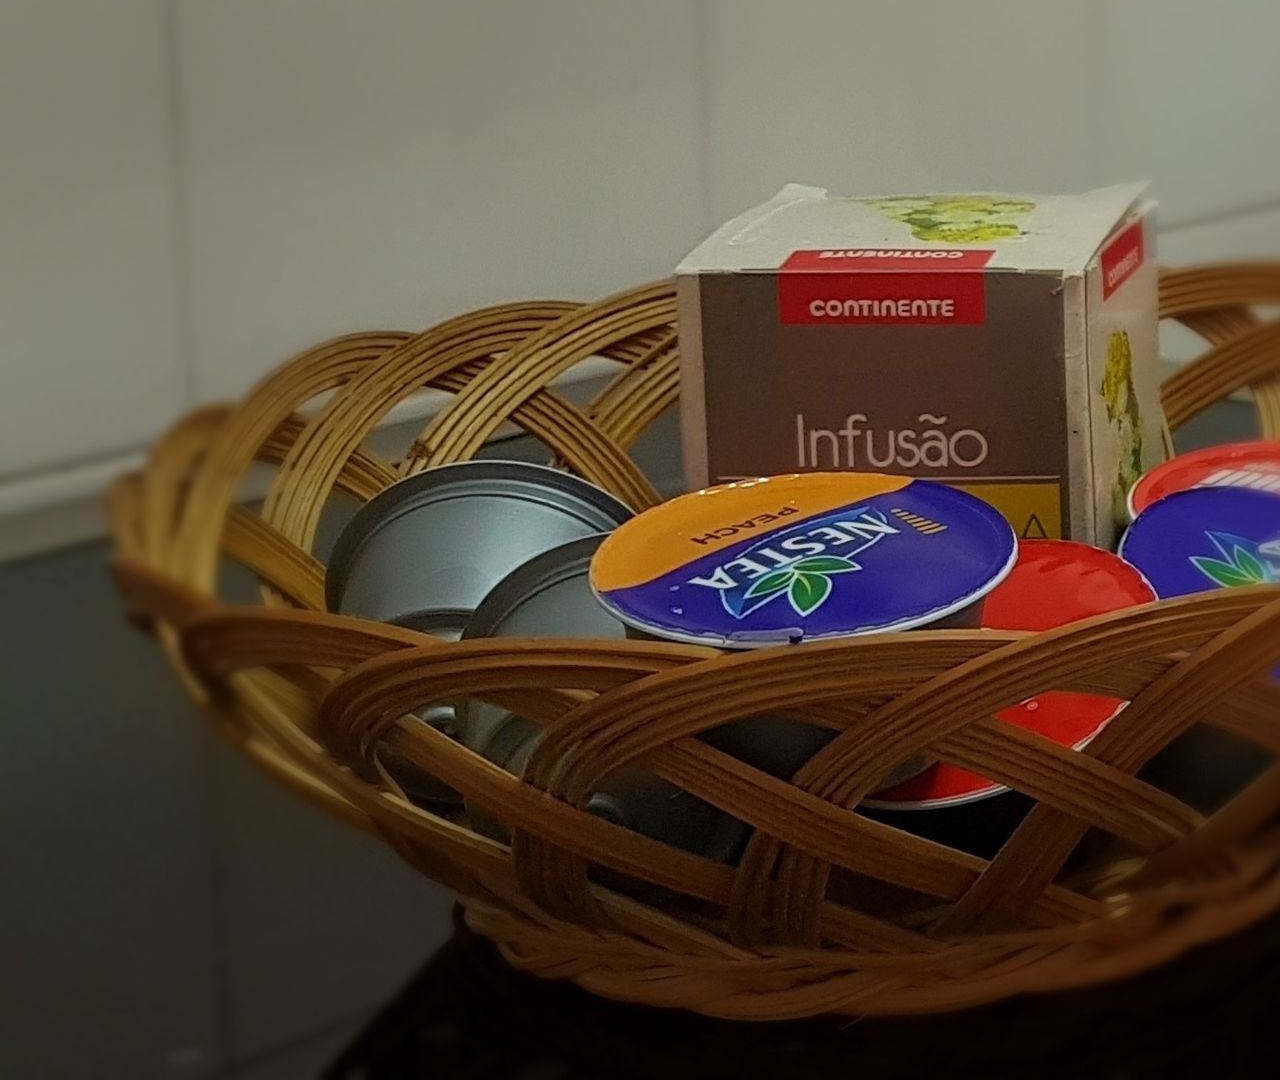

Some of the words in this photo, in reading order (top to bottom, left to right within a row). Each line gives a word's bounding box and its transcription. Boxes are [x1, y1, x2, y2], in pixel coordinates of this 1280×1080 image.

[809, 299, 955, 317] CONTINENTE
[797, 414, 988, 467] Infusão
[690, 506, 799, 545] PEACH
[687, 514, 901, 589] NESTEA
